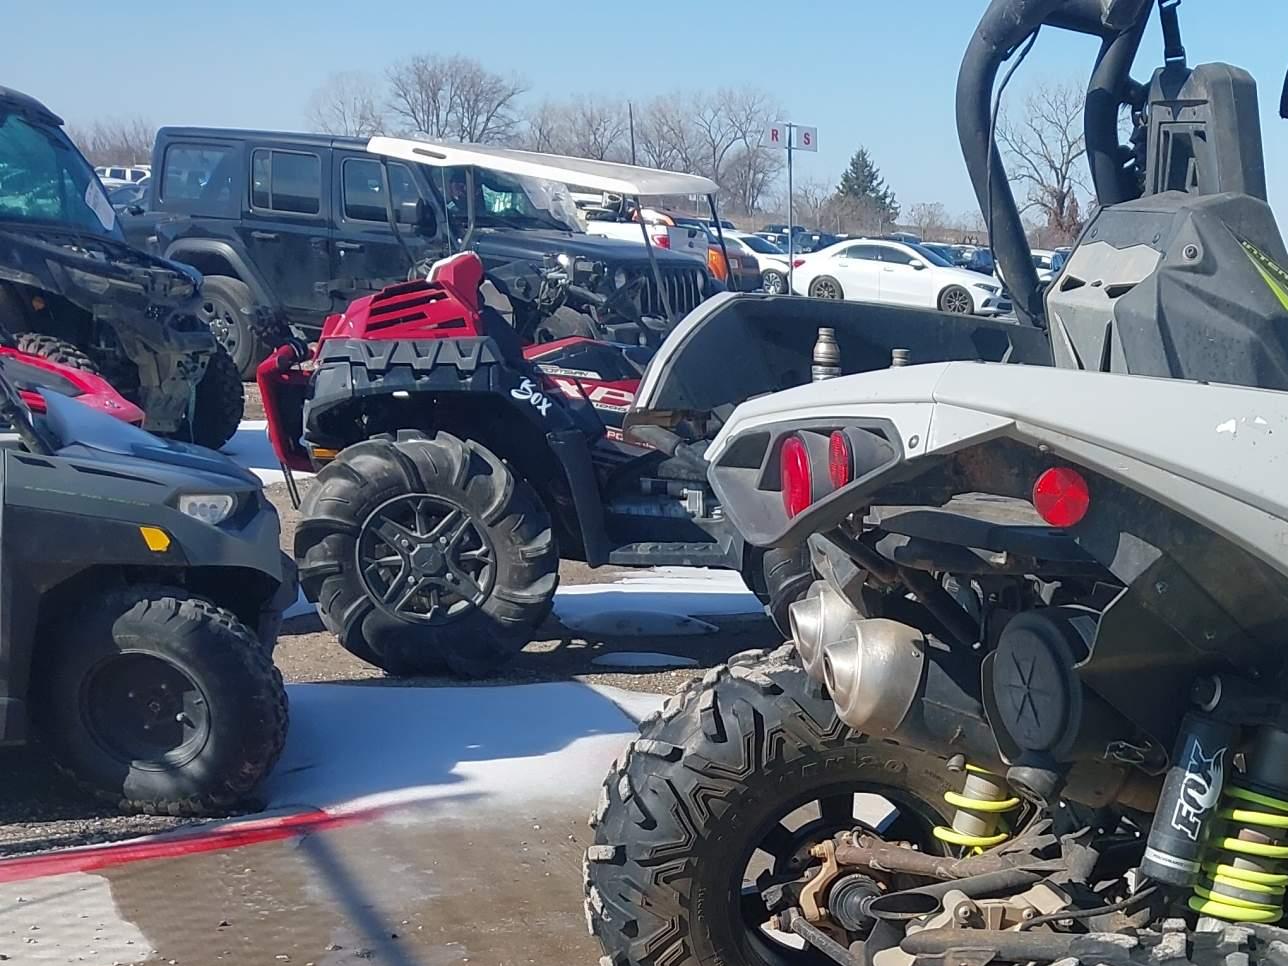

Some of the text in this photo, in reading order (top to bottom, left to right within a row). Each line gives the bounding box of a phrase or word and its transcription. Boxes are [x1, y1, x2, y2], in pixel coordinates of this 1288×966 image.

[771, 128, 779, 142] R
[803, 132, 811, 146] S
[1171, 739, 1227, 841] FOX
